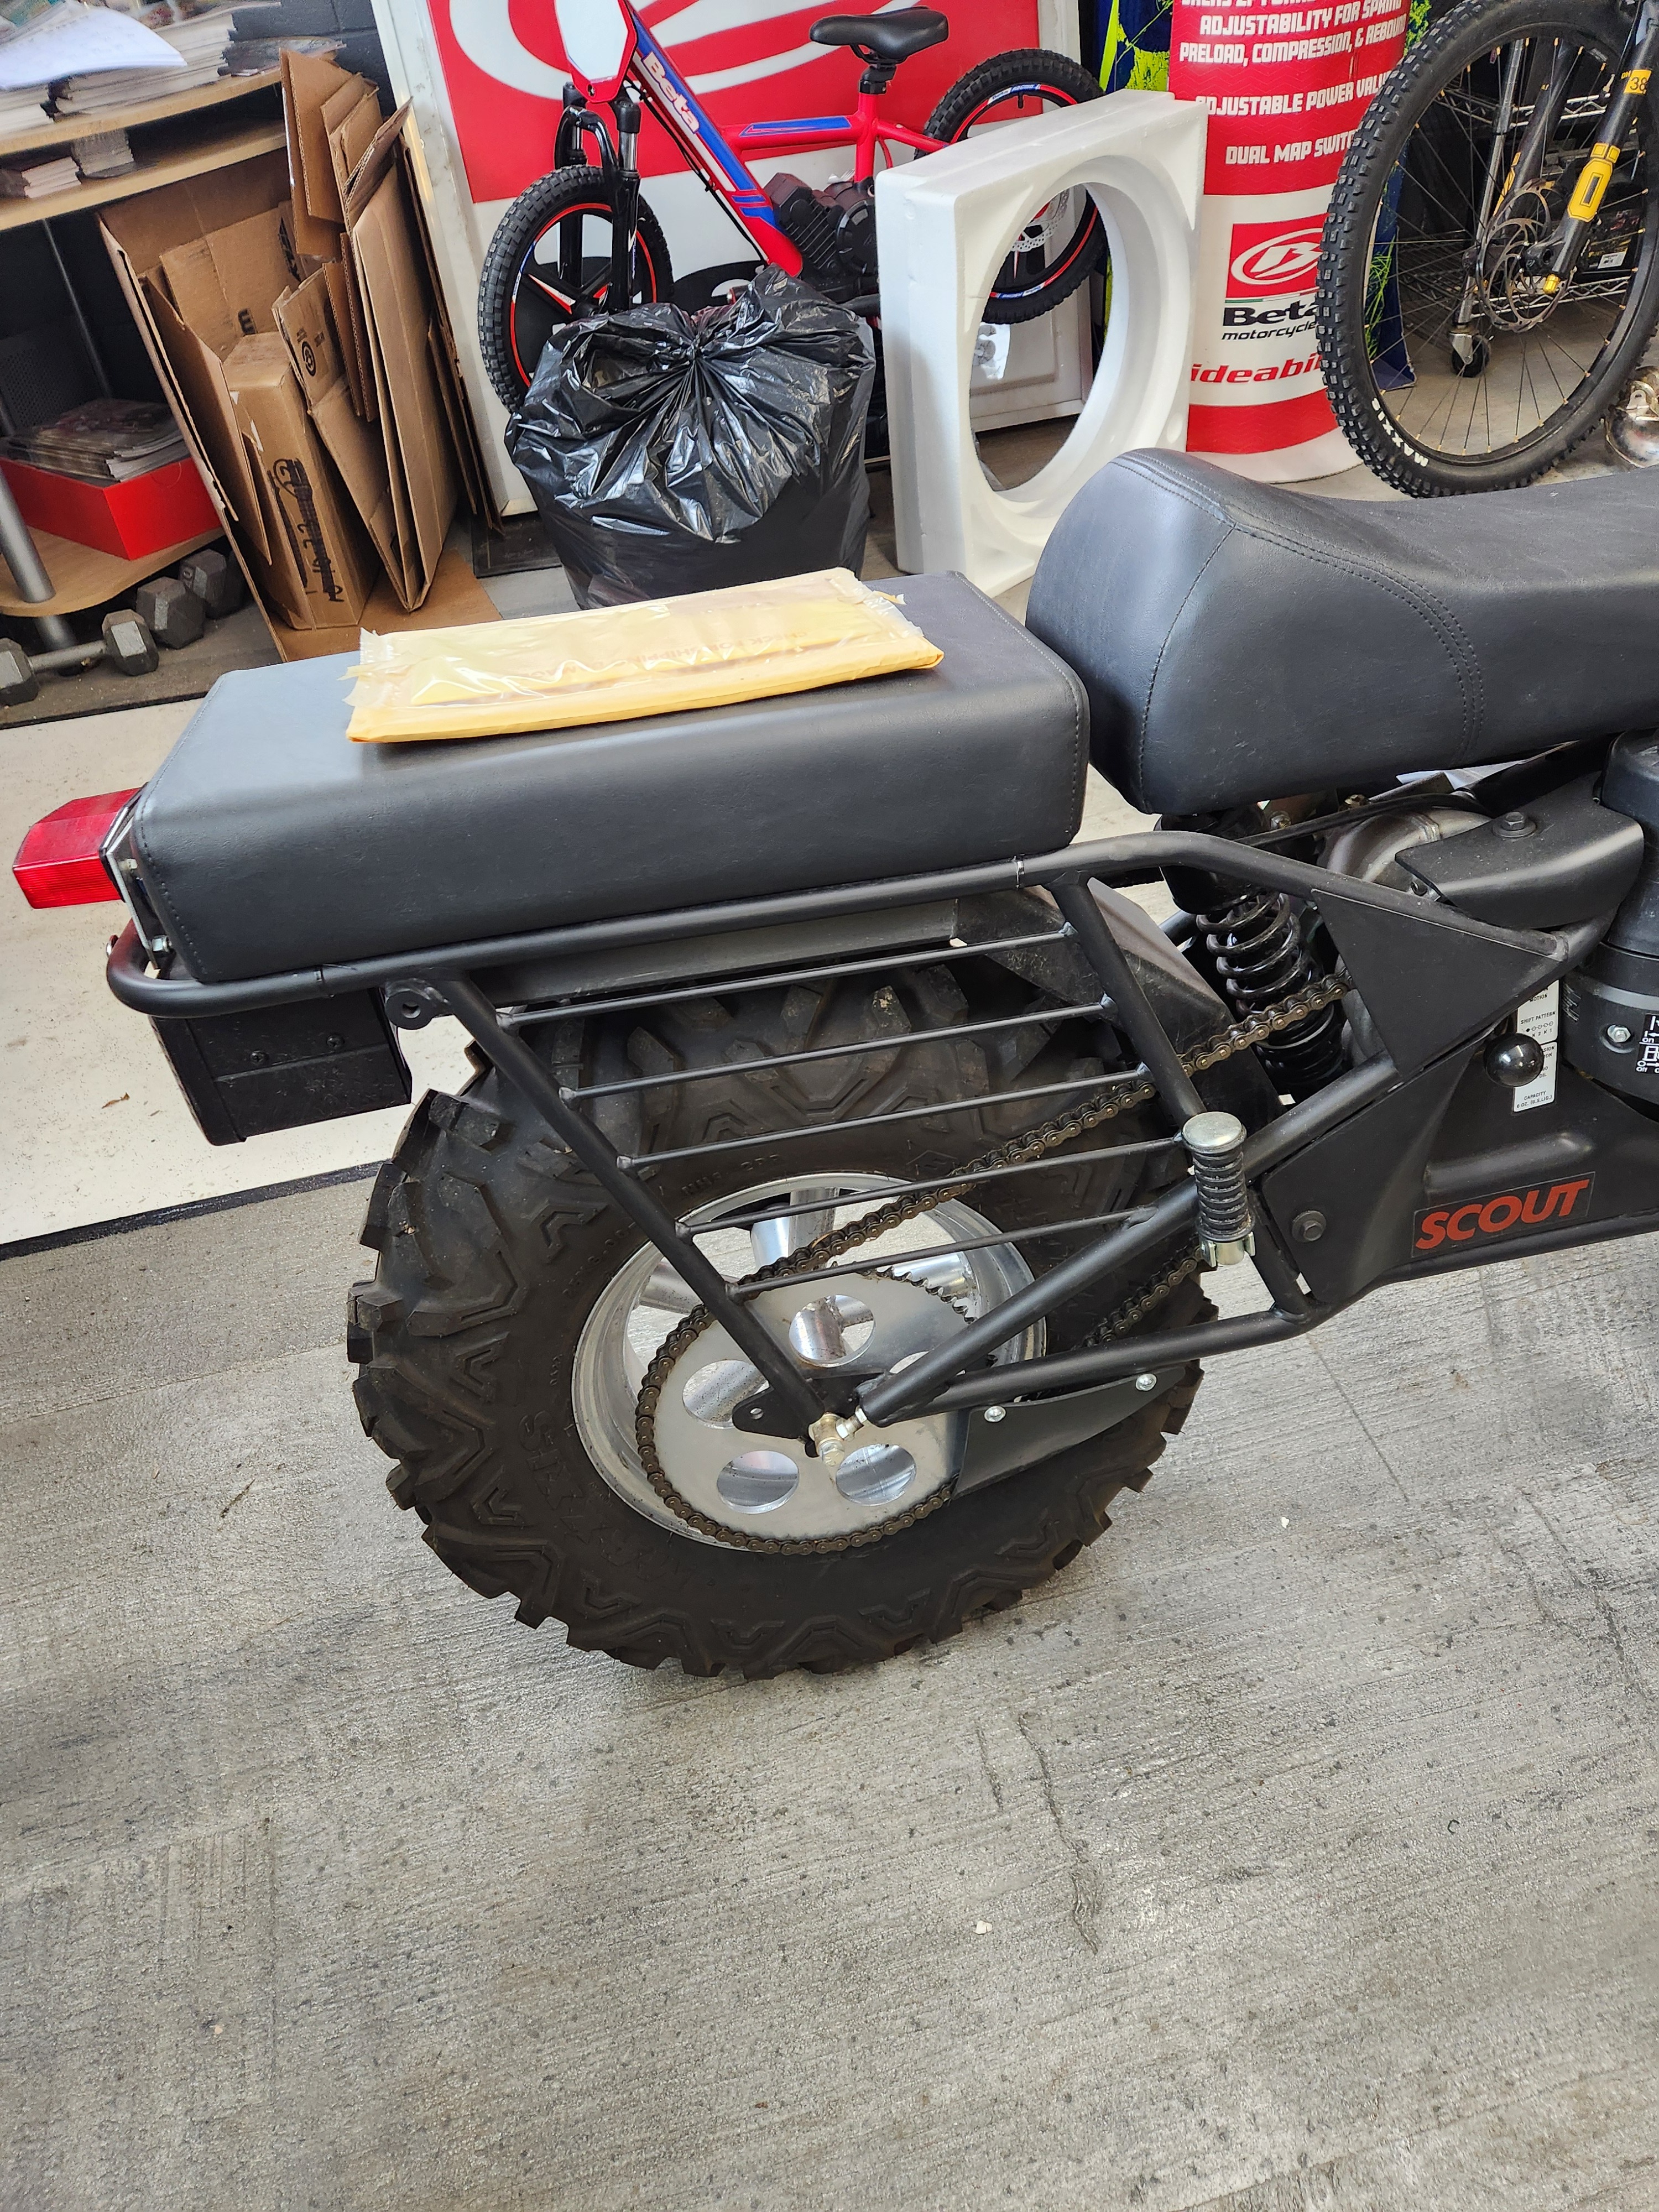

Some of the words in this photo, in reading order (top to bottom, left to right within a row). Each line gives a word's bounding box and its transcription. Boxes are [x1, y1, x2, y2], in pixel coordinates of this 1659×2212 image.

[1200, 7, 1333, 35] ADJUSTABILITY
[1334, 1, 1361, 26] FOR
[1180, 41, 1249, 67] PRELOAD,
[1252, 30, 1353, 63] COMPRESSION,
[1355, 28, 1364, 48] &
[1365, 13, 1407, 45] REBOUND
[641, 51, 700, 134] Beta
[1306, 81, 1354, 111] POWER
[1357, 70, 1392, 98] VALV
[1630, 76, 1647, 91] 38
[1225, 145, 1270, 165] DUAL
[1274, 140, 1313, 163] MAP
[1314, 128, 1359, 158] SWITC
[1223, 300, 1319, 326] Beta
[1372, 398, 1428, 467] MAXXIS
[1535, 1010, 1556, 1020] PATTERN
[1524, 1091, 1546, 1100] CAPACITY
[1415, 1180, 1590, 1250] SCOUT
